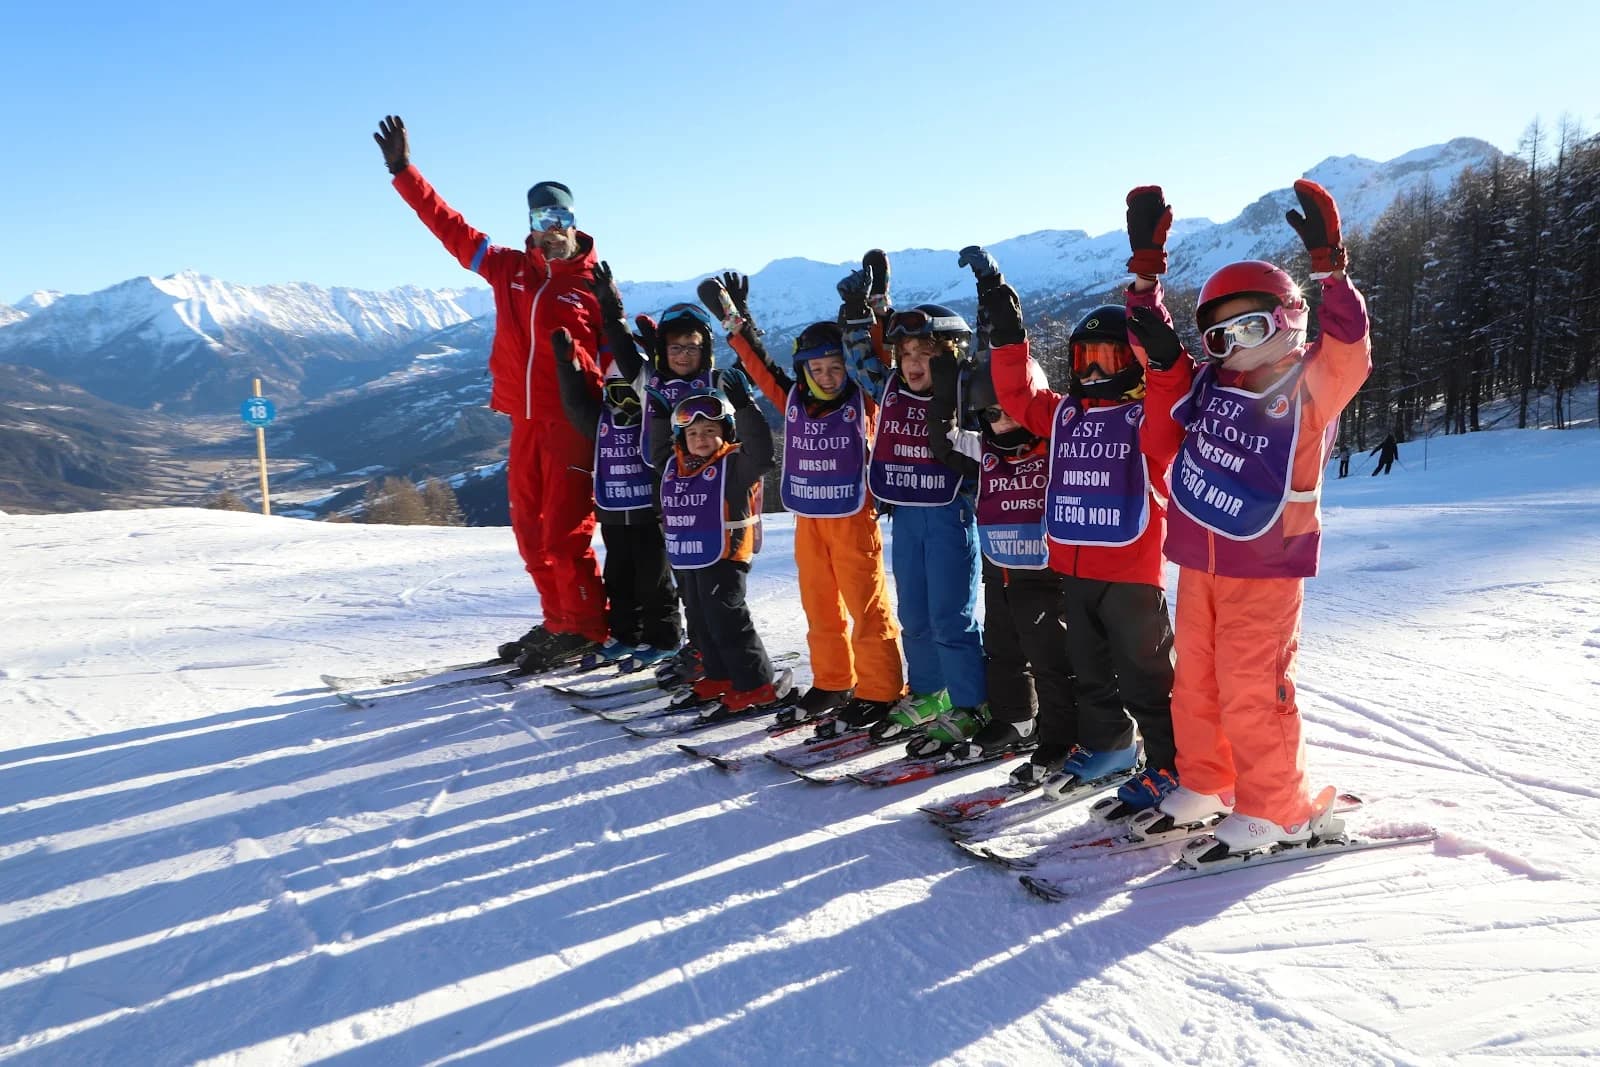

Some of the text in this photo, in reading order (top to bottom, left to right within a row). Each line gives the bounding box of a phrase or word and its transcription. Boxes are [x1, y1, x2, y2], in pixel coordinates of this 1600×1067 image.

[1206, 397, 1245, 421] ESF
[804, 422, 828, 436] ESF
[1072, 421, 1106, 438] ESF
[792, 435, 850, 451] PRALOUP
[1058, 442, 1131, 460] PRALOUP
[799, 459, 837, 471] OURSON
[896, 473, 918, 489] COQ
[920, 474, 946, 489] NOIR
[1063, 470, 1110, 487] OURSON
[615, 486, 632, 498] COQ
[1204, 484, 1244, 518] NOIR
[1055, 505, 1121, 527] LE COQ NOIR
